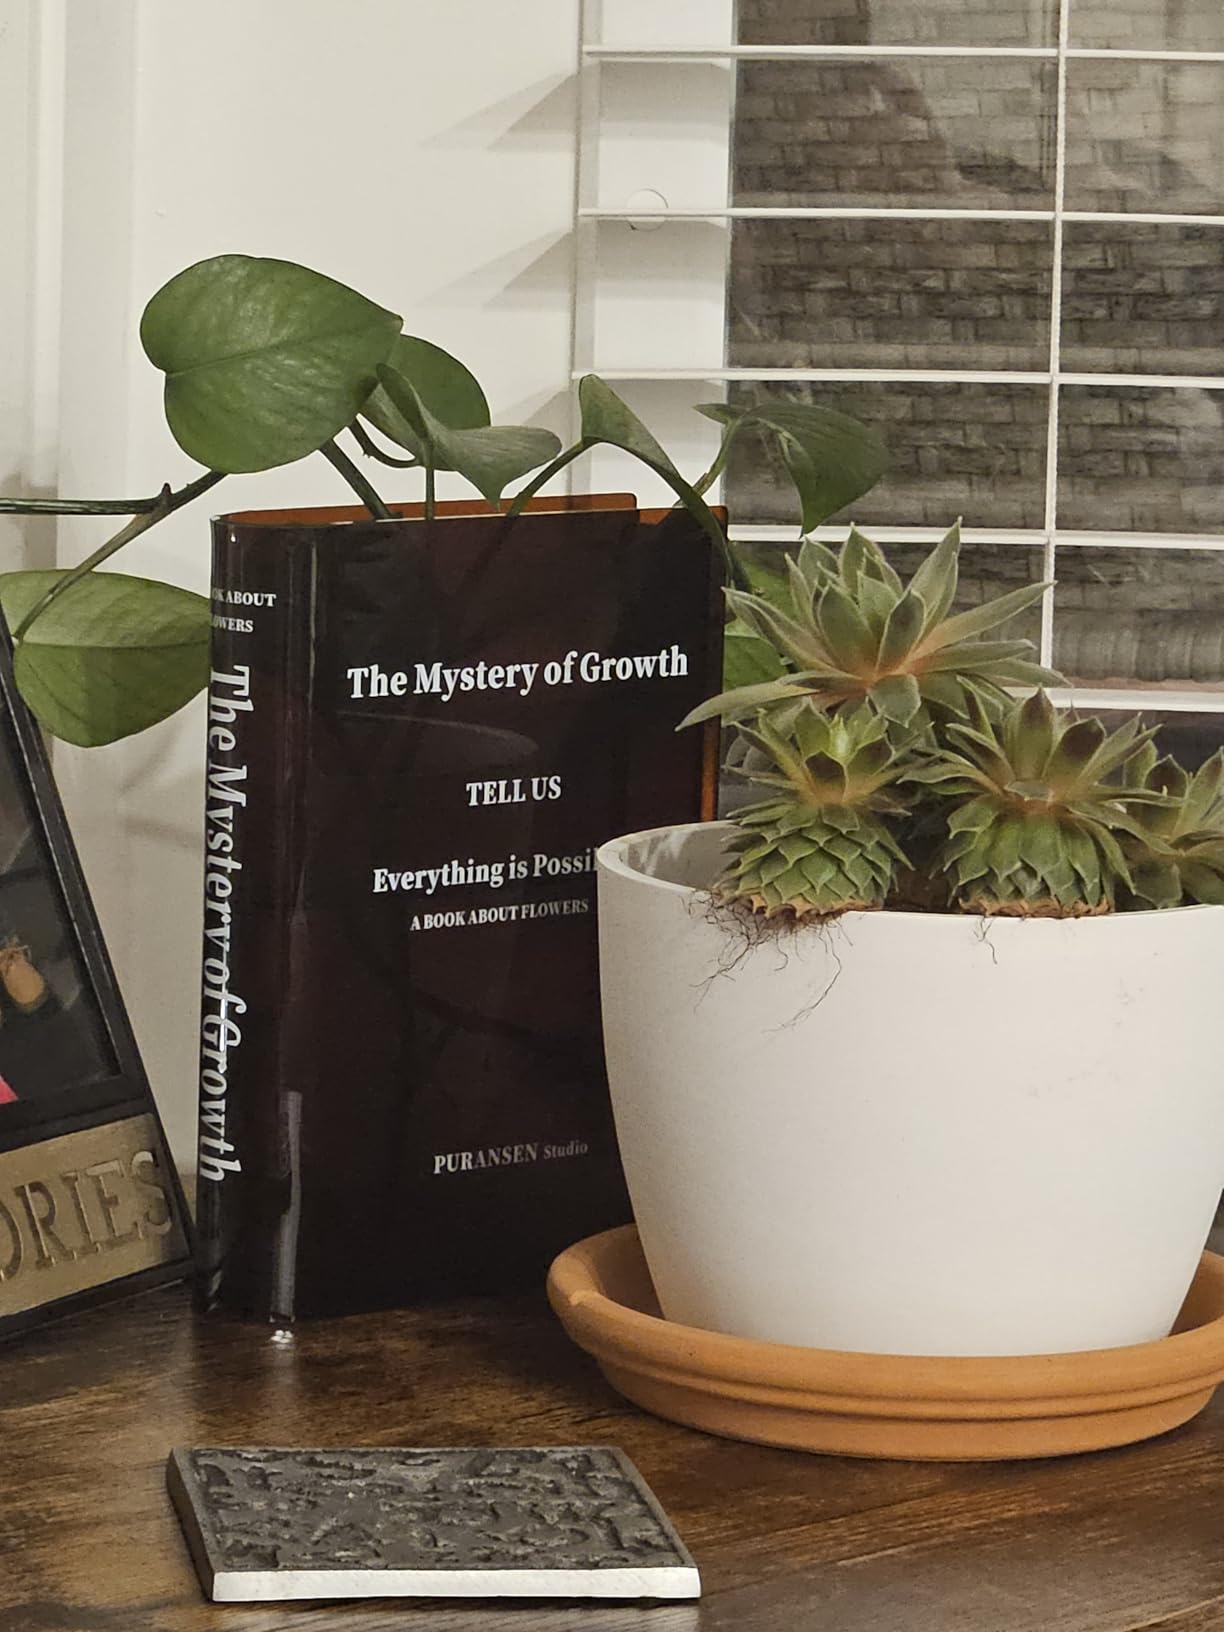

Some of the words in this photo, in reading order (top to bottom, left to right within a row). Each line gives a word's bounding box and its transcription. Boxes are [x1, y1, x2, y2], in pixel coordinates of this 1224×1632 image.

[226, 590, 277, 607] ABOUT
[211, 615, 254, 633] OWERS
[347, 664, 408, 698] The
[413, 661, 539, 702] Mystery
[543, 651, 578, 685] of
[579, 645, 689, 683] Growth
[209, 664, 254, 752] The
[465, 779, 527, 807] TELL
[531, 776, 562, 800] US
[372, 859, 505, 896] Everything
[509, 855, 528, 880] is
[409, 914, 421, 932] A
[423, 909, 466, 930] BOOK
[467, 905, 518, 926] ABOUT
[520, 898, 590, 920] FLOWERS
[199, 1014, 243, 1182] Growth
[432, 1142, 540, 1175] PURANSEN
[542, 1139, 589, 1160] Studio
